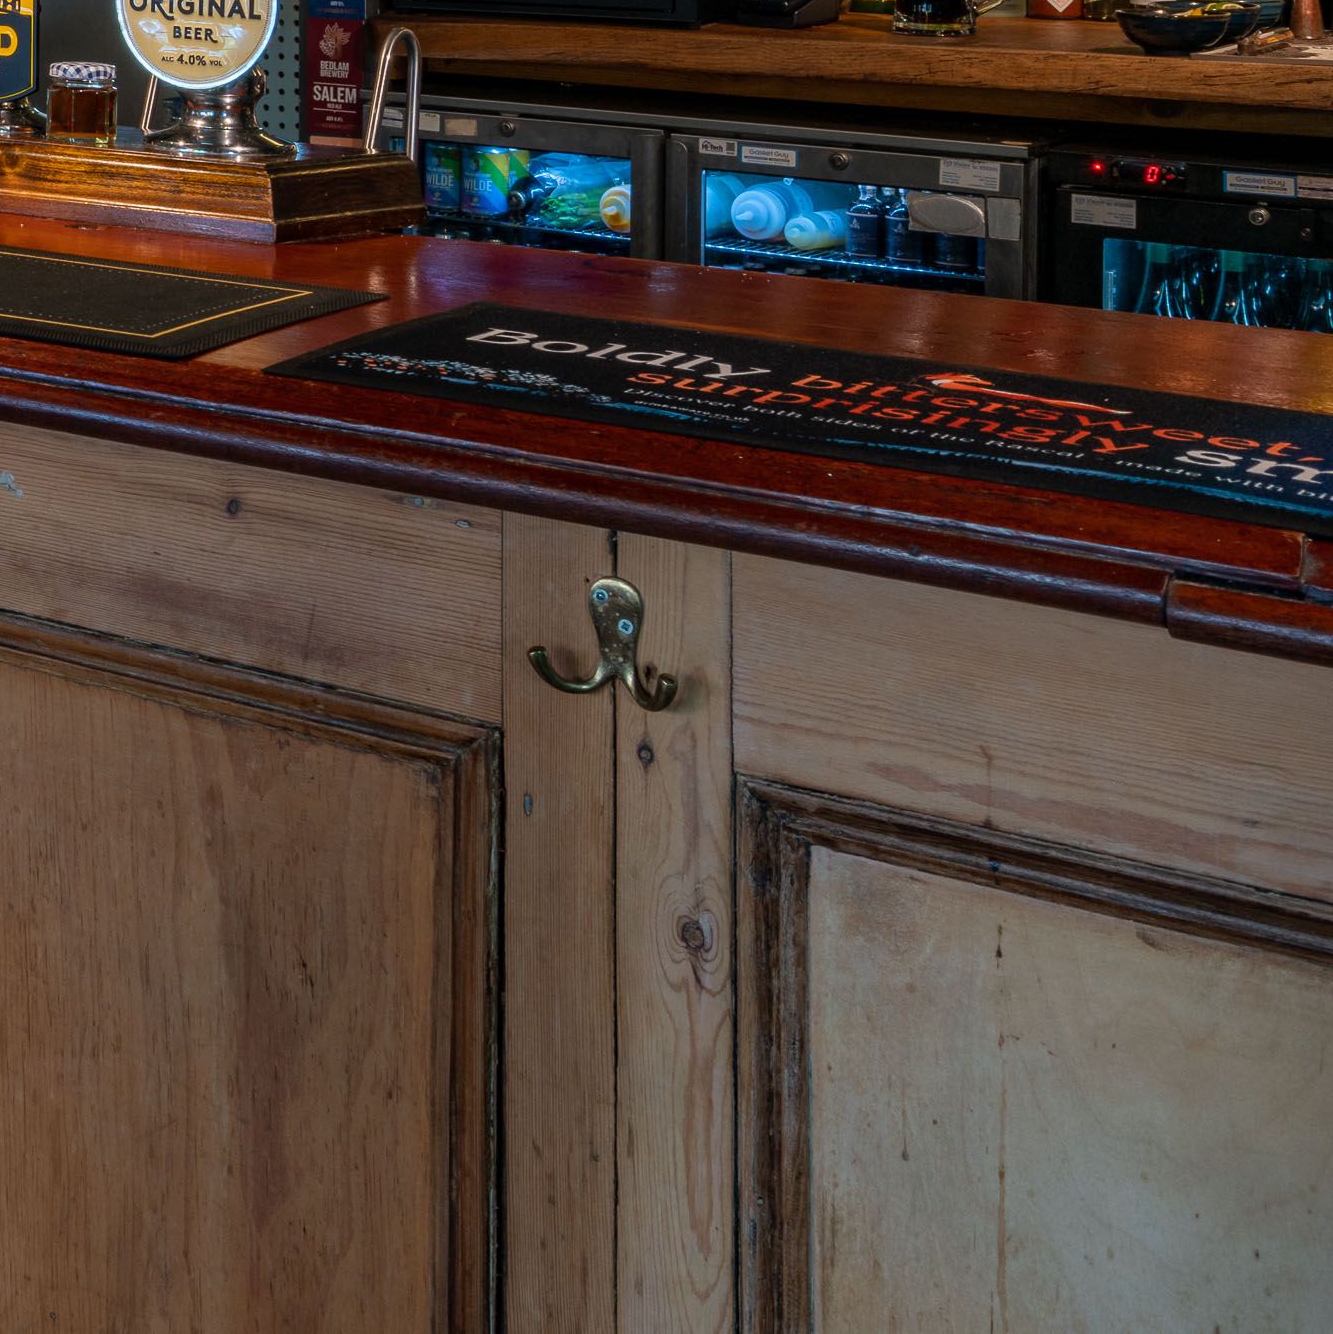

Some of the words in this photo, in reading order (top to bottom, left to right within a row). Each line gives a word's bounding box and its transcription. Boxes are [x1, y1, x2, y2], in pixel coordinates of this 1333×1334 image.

[172, 25, 219, 44] BEER
[176, 54, 207, 67] 4.0%
[209, 59, 223, 67] VOL
[319, 60, 350, 71] BEDLAM
[319, 69, 349, 79] BREWERY
[313, 85, 357, 104] SALEM
[748, 148, 773, 157] Gasket
[773, 150, 789, 159] Guy
[425, 172, 454, 187] WILDE
[463, 178, 493, 192] WILDE
[1235, 175, 1266, 185] Gasket
[1267, 177, 1286, 188] Guy
[466, 327, 771, 380] Boldly
[627, 371, 1150, 455] surprisingly
[623, 388, 736, 409] Discover
[741, 406, 803, 419] both
[825, 414, 883, 433] sides
[889, 424, 925, 437] of
[929, 431, 976, 446] the
[983, 438, 1086, 461] Rascal
[1115, 459, 1202, 478] made
[1214, 475, 1285, 493] with
